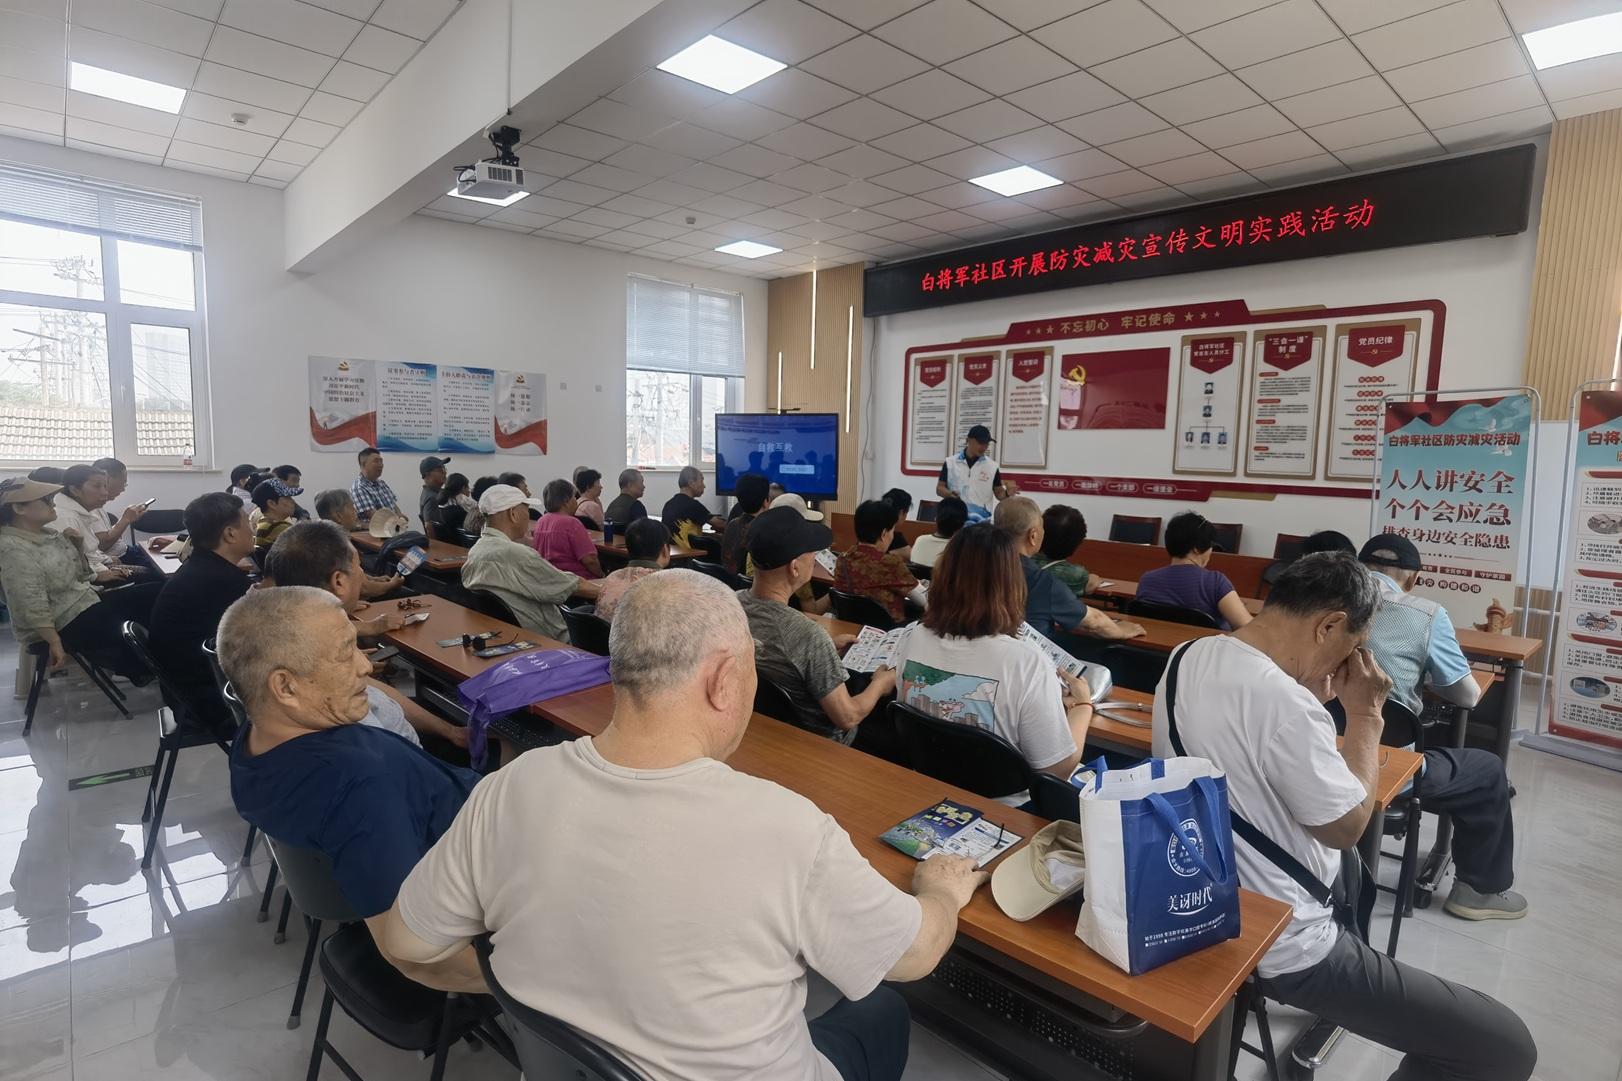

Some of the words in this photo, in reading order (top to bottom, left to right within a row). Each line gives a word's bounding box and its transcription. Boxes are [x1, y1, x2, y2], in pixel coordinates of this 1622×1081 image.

[921, 199, 1375, 292] 白将军社区开展防灾减灾宣传文明实践活动
[1060, 318, 1109, 335] 不忘初心
[1121, 311, 1175, 329] 牢记使命
[1358, 335, 1393, 346] 党员纪律
[758, 442, 793, 453] 自救互救
[1388, 431, 1521, 448] 白将军社区防灾减灾活动
[1587, 430, 1622, 446] 白将
[1386, 469, 1515, 494] 人人讲安全
[1384, 498, 1512, 526] 个个会应急
[1383, 525, 1511, 550] 排查身边安全隐患
